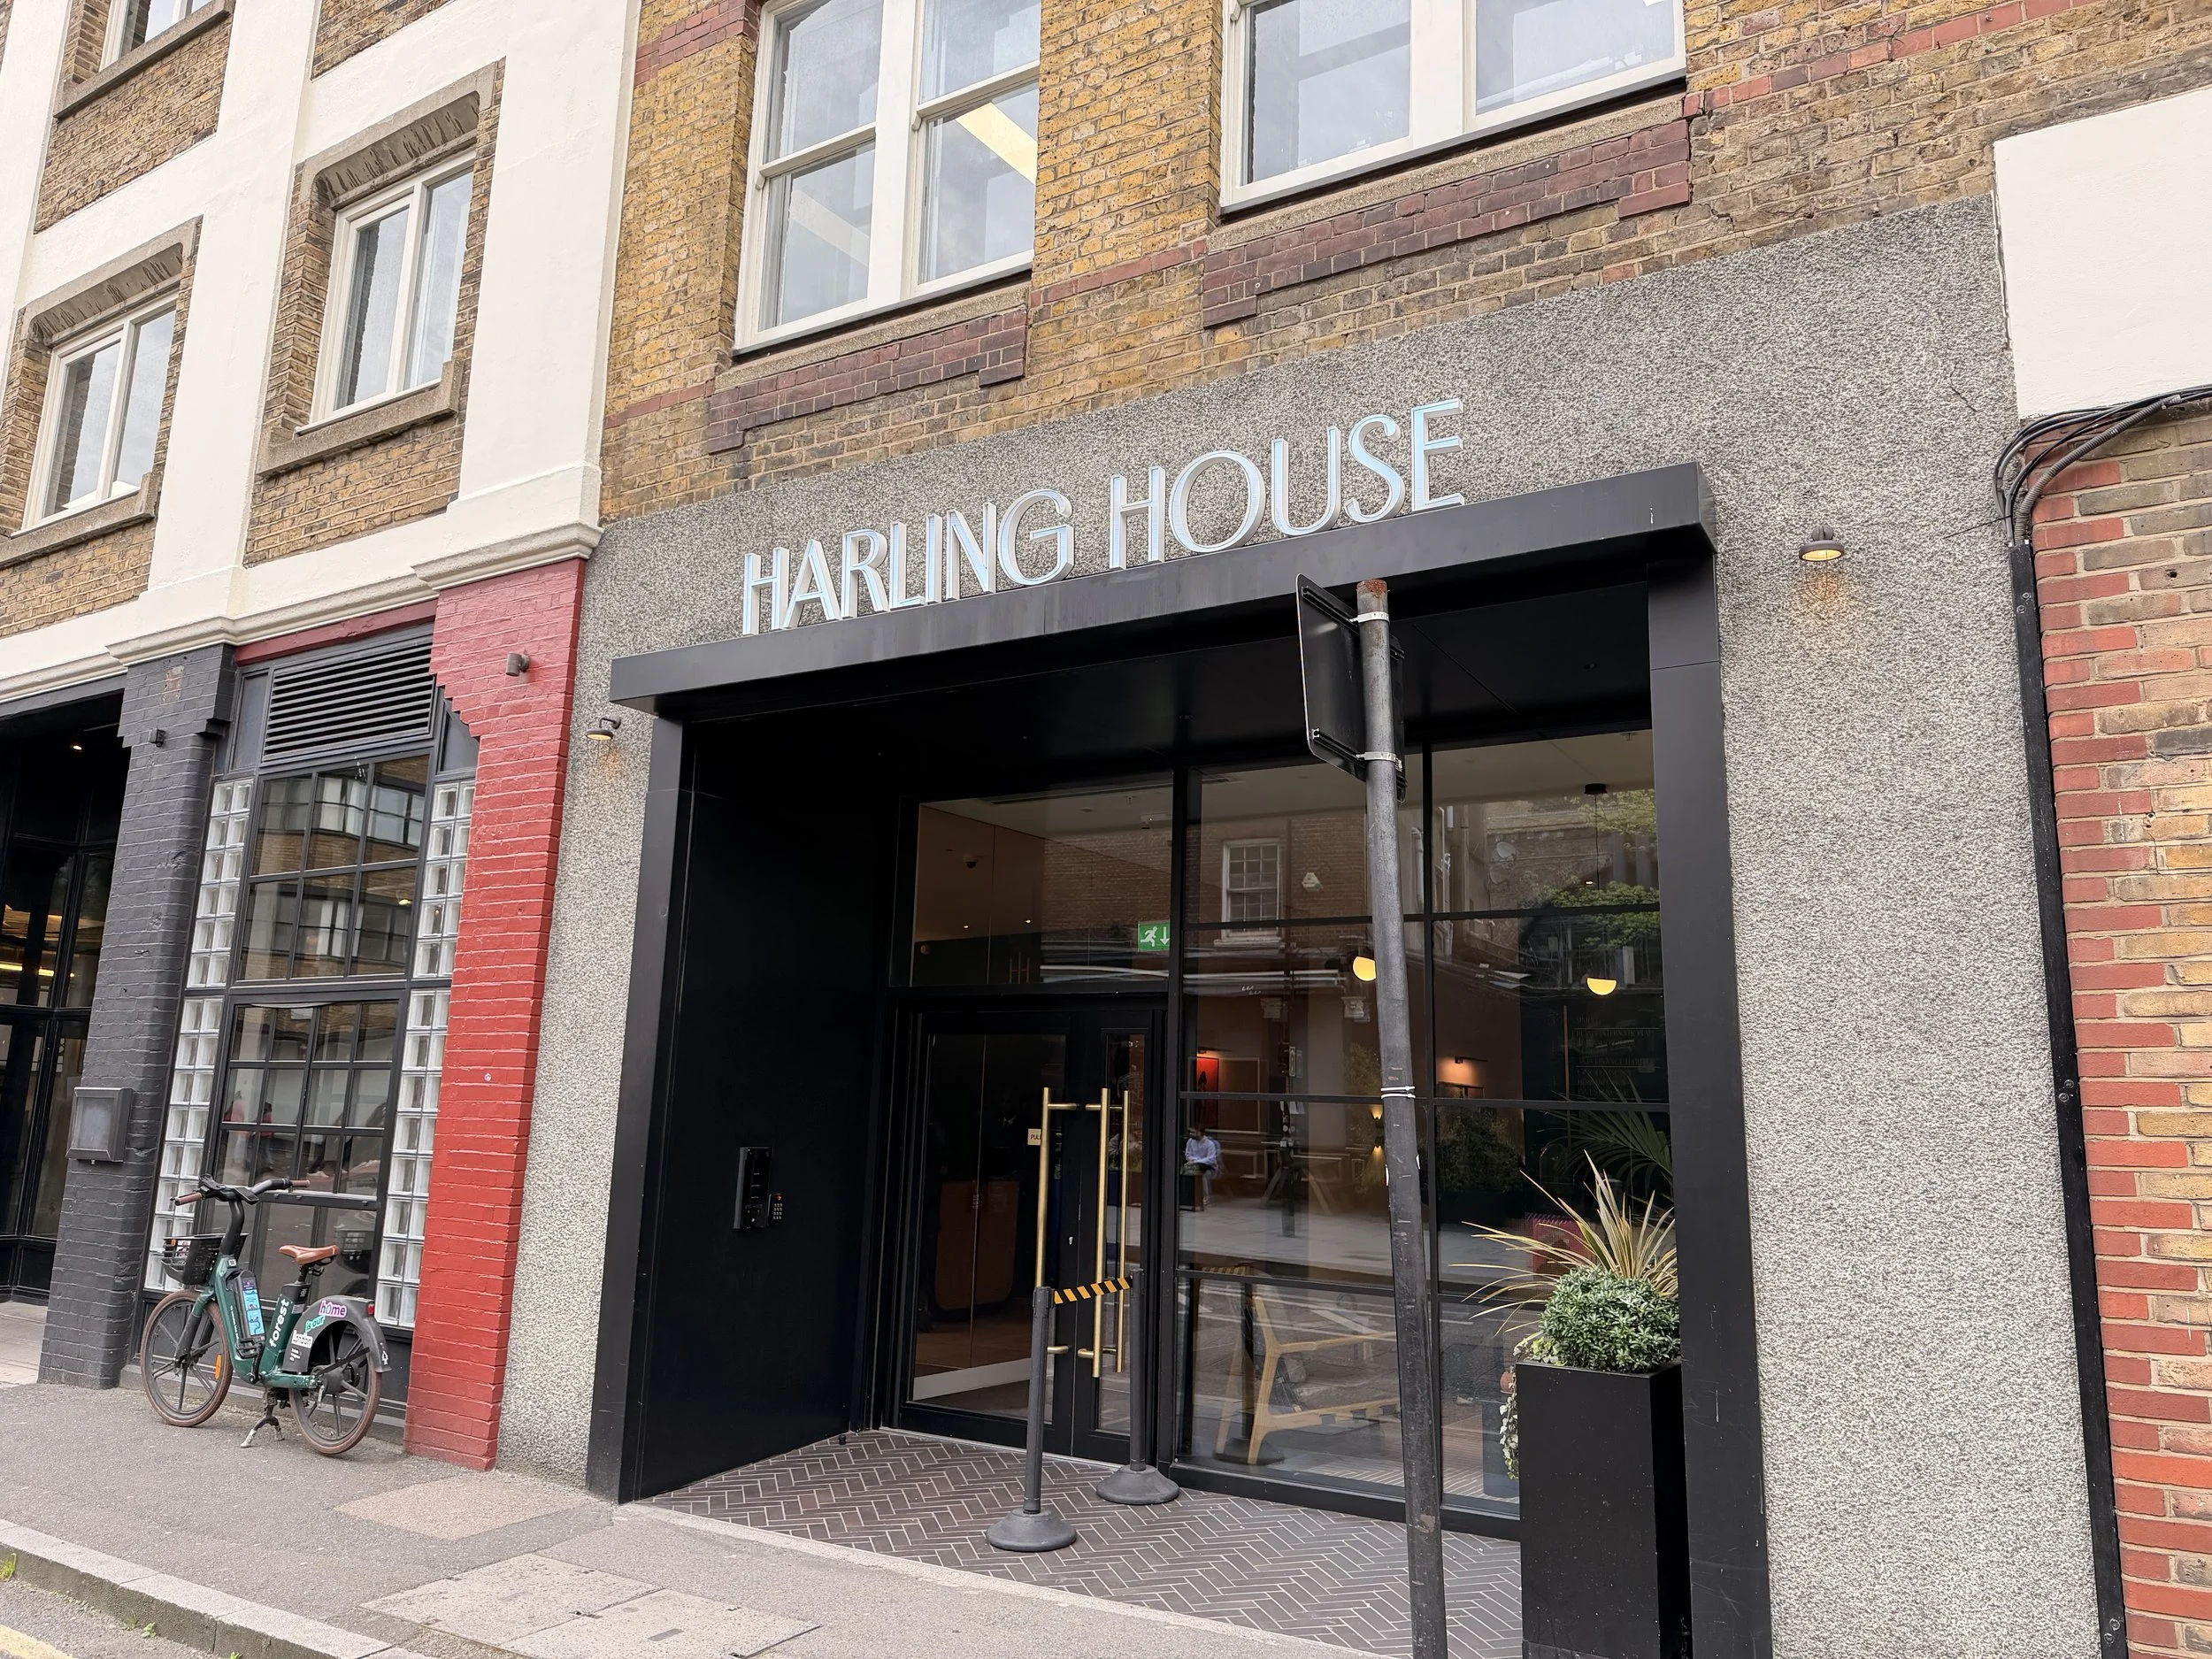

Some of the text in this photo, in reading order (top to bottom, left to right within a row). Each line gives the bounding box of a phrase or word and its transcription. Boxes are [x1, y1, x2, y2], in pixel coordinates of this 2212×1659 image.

[742, 398, 1465, 635] HARLING HOUSE
[269, 1298, 290, 1348] forest
[319, 1301, 346, 1317] home
